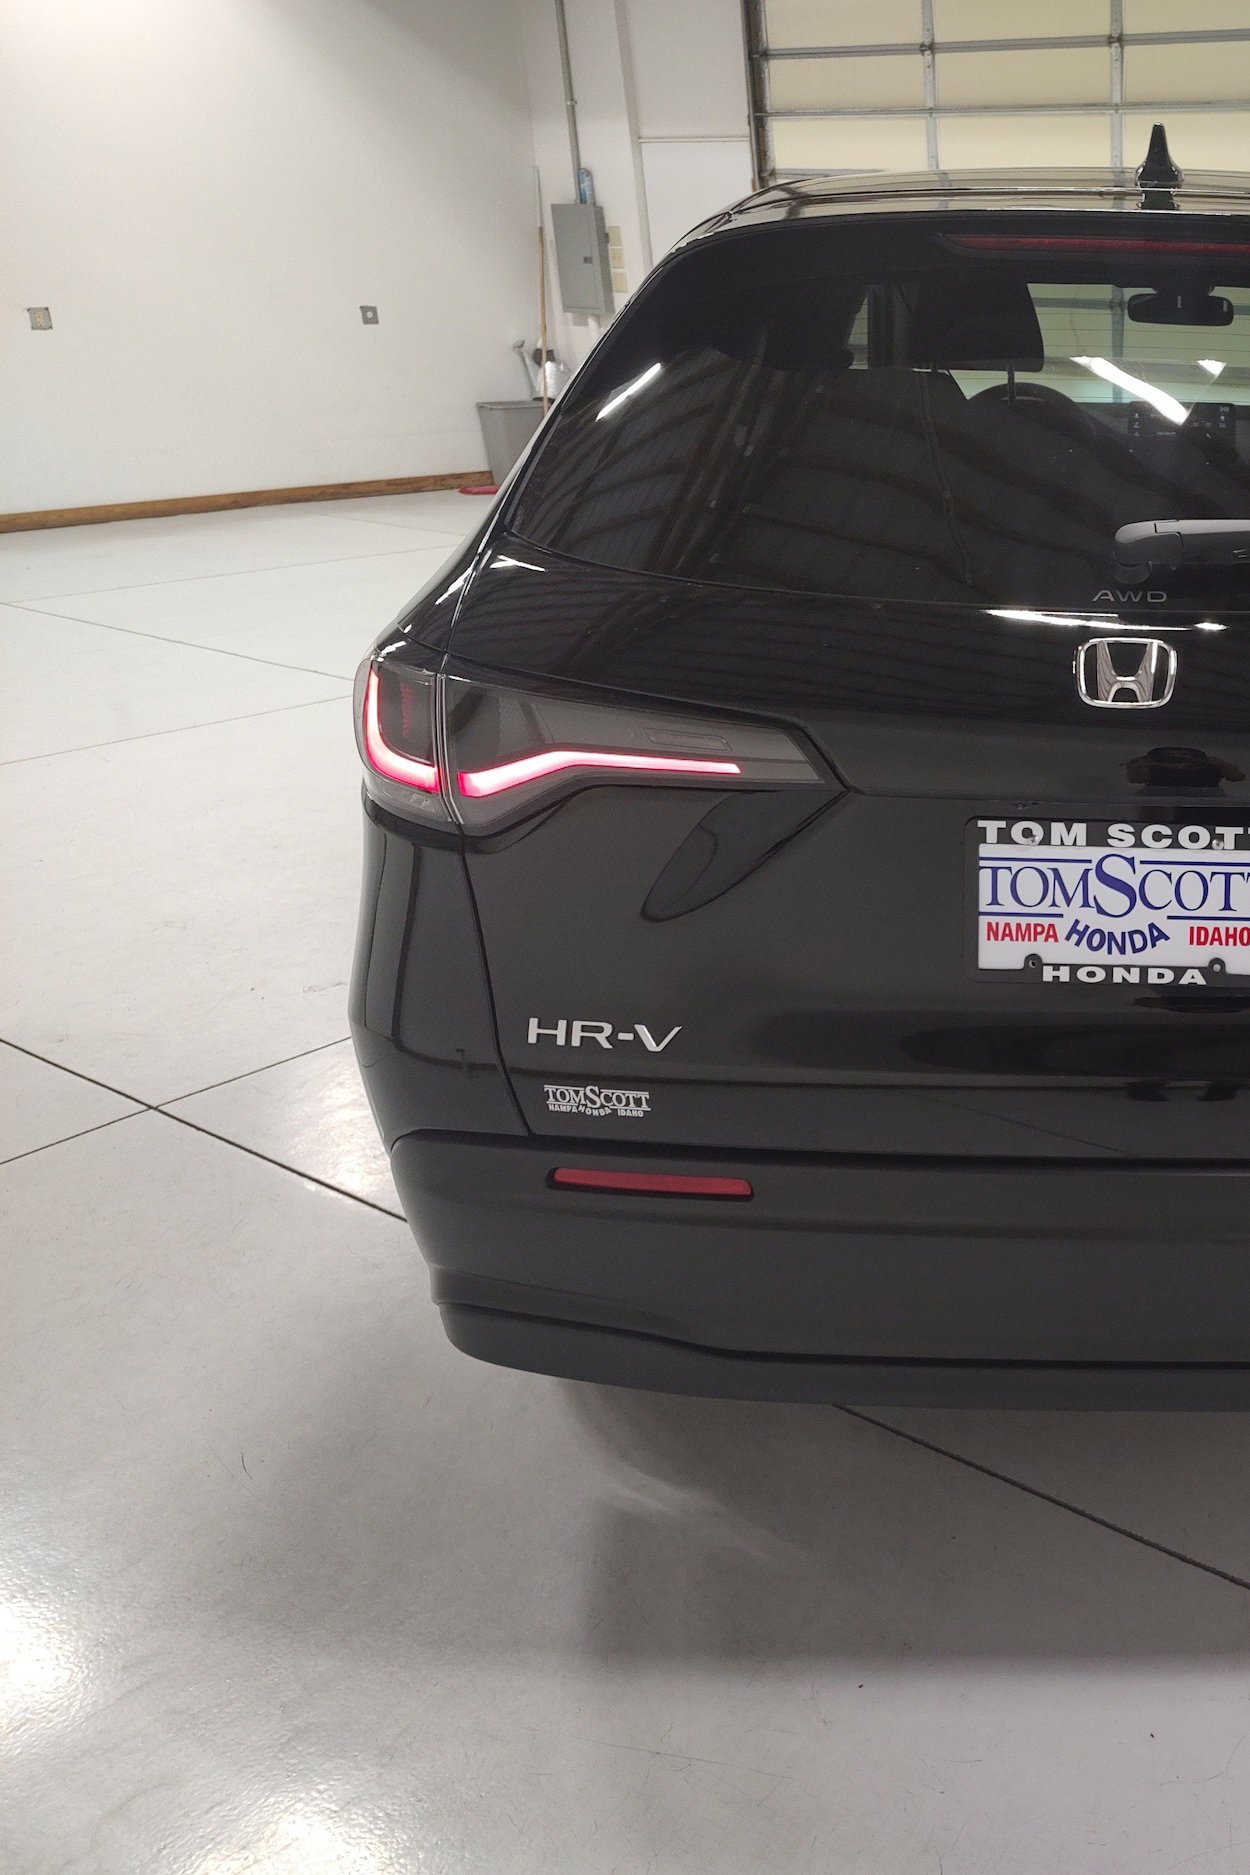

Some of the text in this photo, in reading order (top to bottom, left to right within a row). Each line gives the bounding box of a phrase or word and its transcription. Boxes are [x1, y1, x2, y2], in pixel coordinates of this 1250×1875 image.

[1092, 589, 1167, 603] AWD
[977, 820, 1087, 846] TOM
[986, 922, 1059, 943] NAMPA
[1064, 918, 1170, 956] HONDA
[1042, 965, 1207, 986] HONDA
[527, 1017, 683, 1052] HR-V
[548, 1104, 644, 1118] NAMPA HONDA IDAHO
